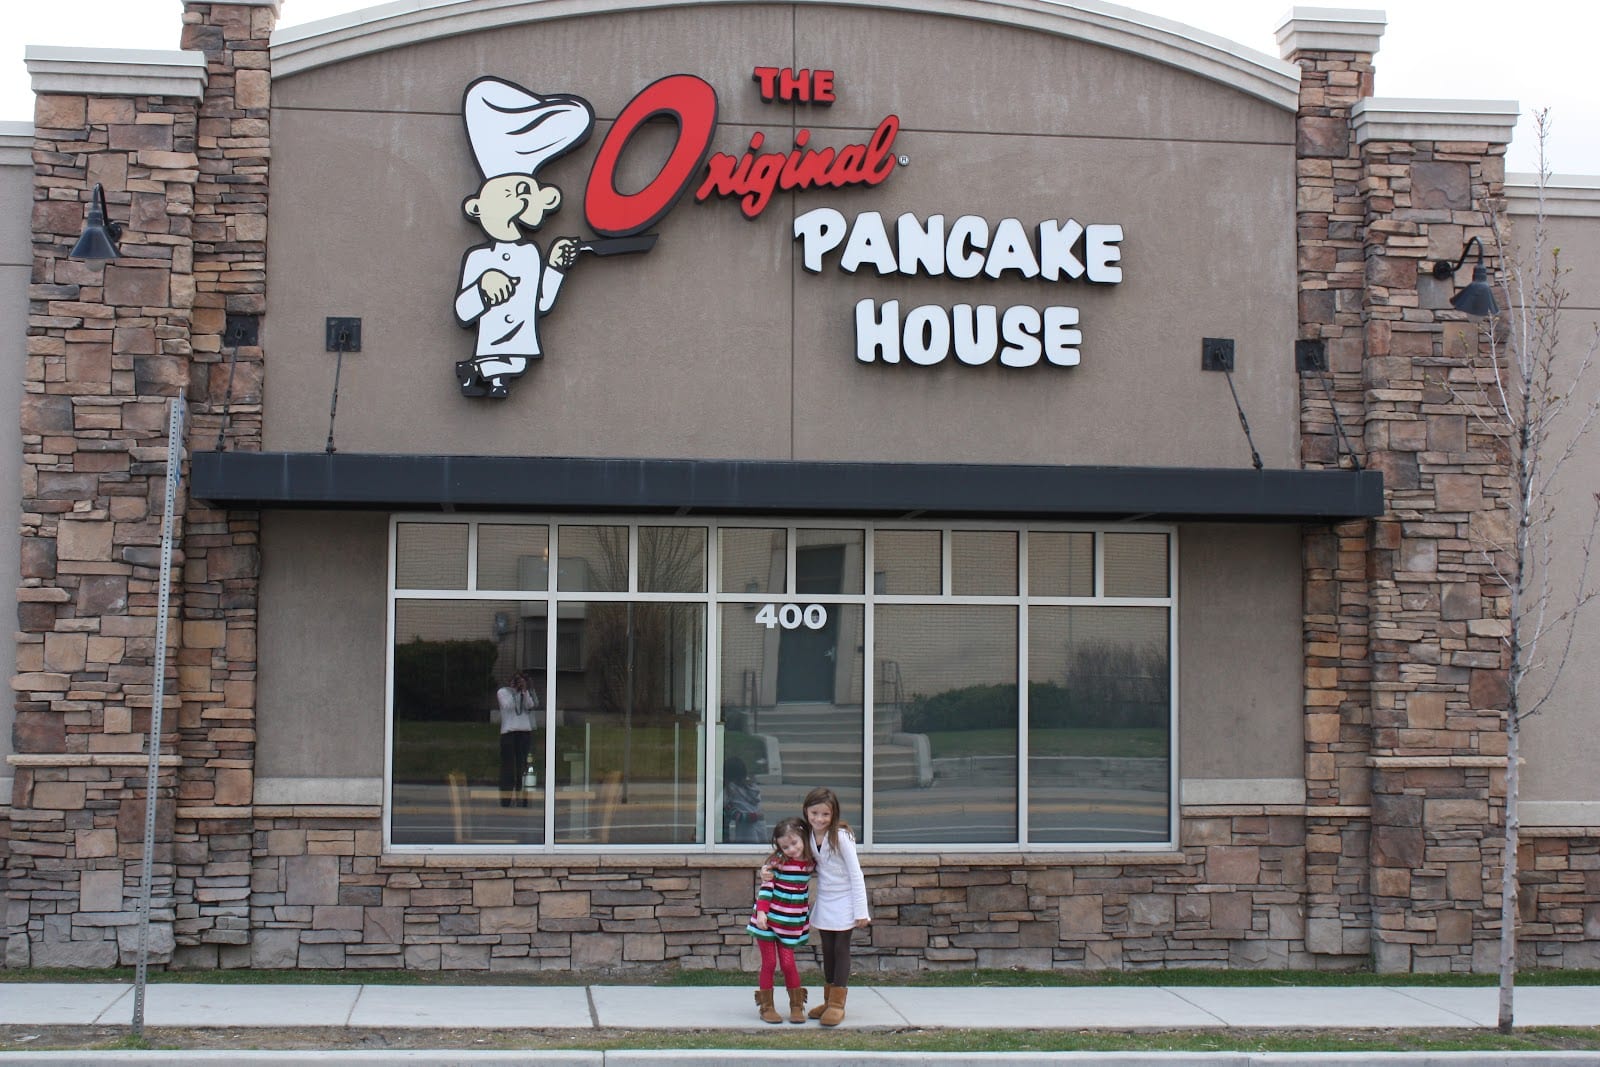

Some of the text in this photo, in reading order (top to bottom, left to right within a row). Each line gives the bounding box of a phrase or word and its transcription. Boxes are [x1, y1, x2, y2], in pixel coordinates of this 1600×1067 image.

[753, 66, 836, 104] THE
[584, 73, 900, 238] Original
[793, 207, 1124, 284] PANCAKE
[855, 298, 1083, 368] HOUSE
[755, 603, 827, 630] 400
